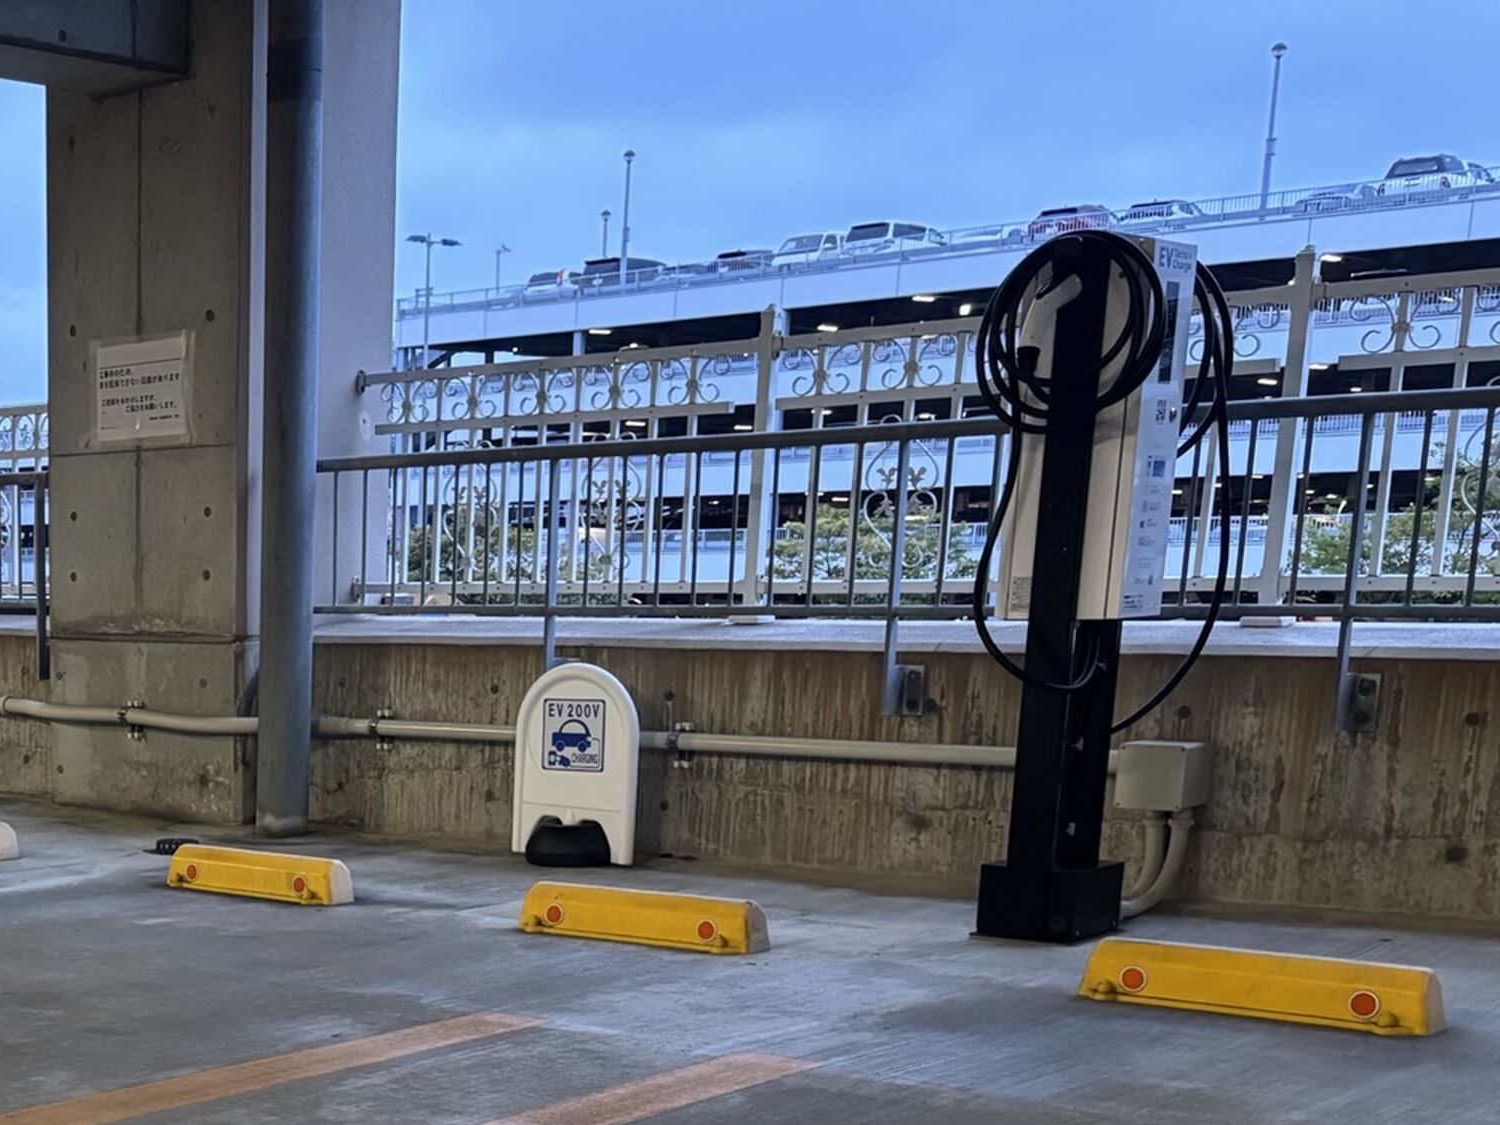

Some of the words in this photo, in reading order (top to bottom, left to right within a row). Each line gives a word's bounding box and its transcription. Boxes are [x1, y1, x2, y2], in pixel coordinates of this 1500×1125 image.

[1158, 246, 1174, 268] EV
[548, 703, 564, 717] EV
[567, 703, 600, 718] 200V
